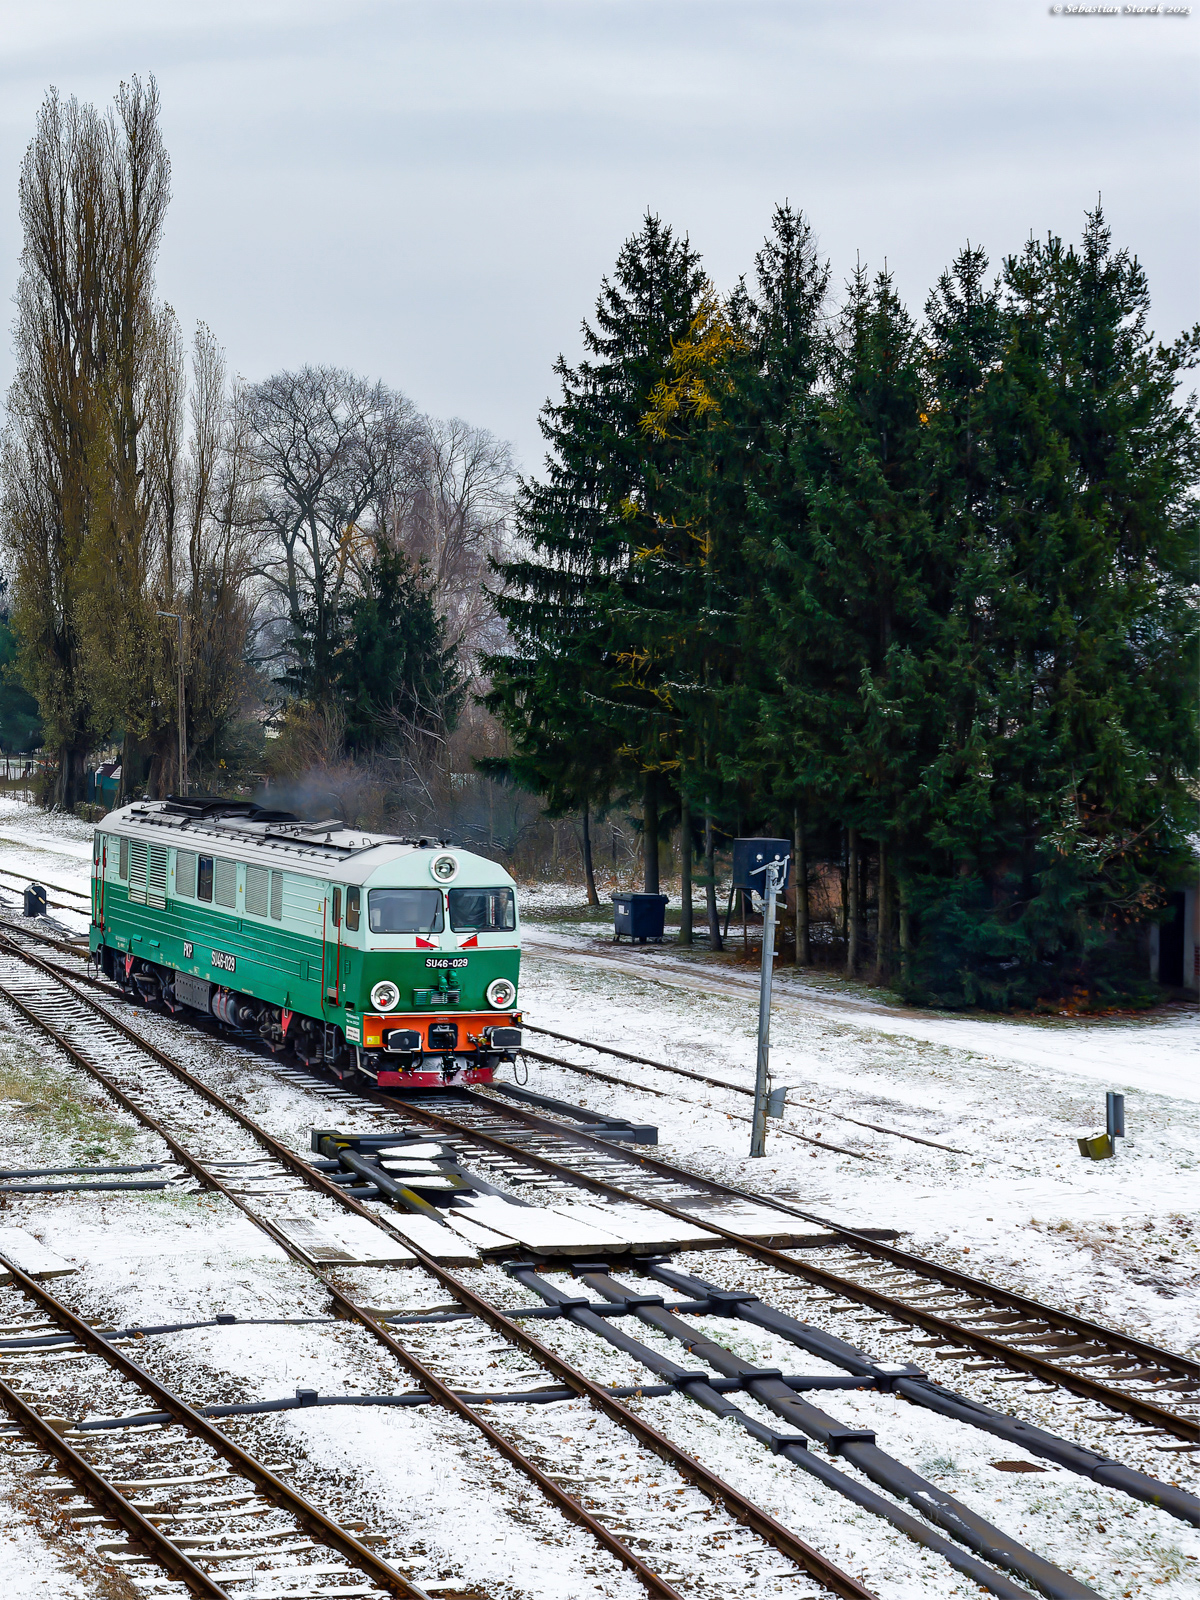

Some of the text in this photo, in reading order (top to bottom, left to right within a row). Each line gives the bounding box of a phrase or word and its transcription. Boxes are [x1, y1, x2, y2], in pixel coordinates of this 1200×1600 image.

[183, 942, 193, 958] PKP
[211, 950, 235, 972] SU46-029
[425, 958, 468, 968] SU46-029
